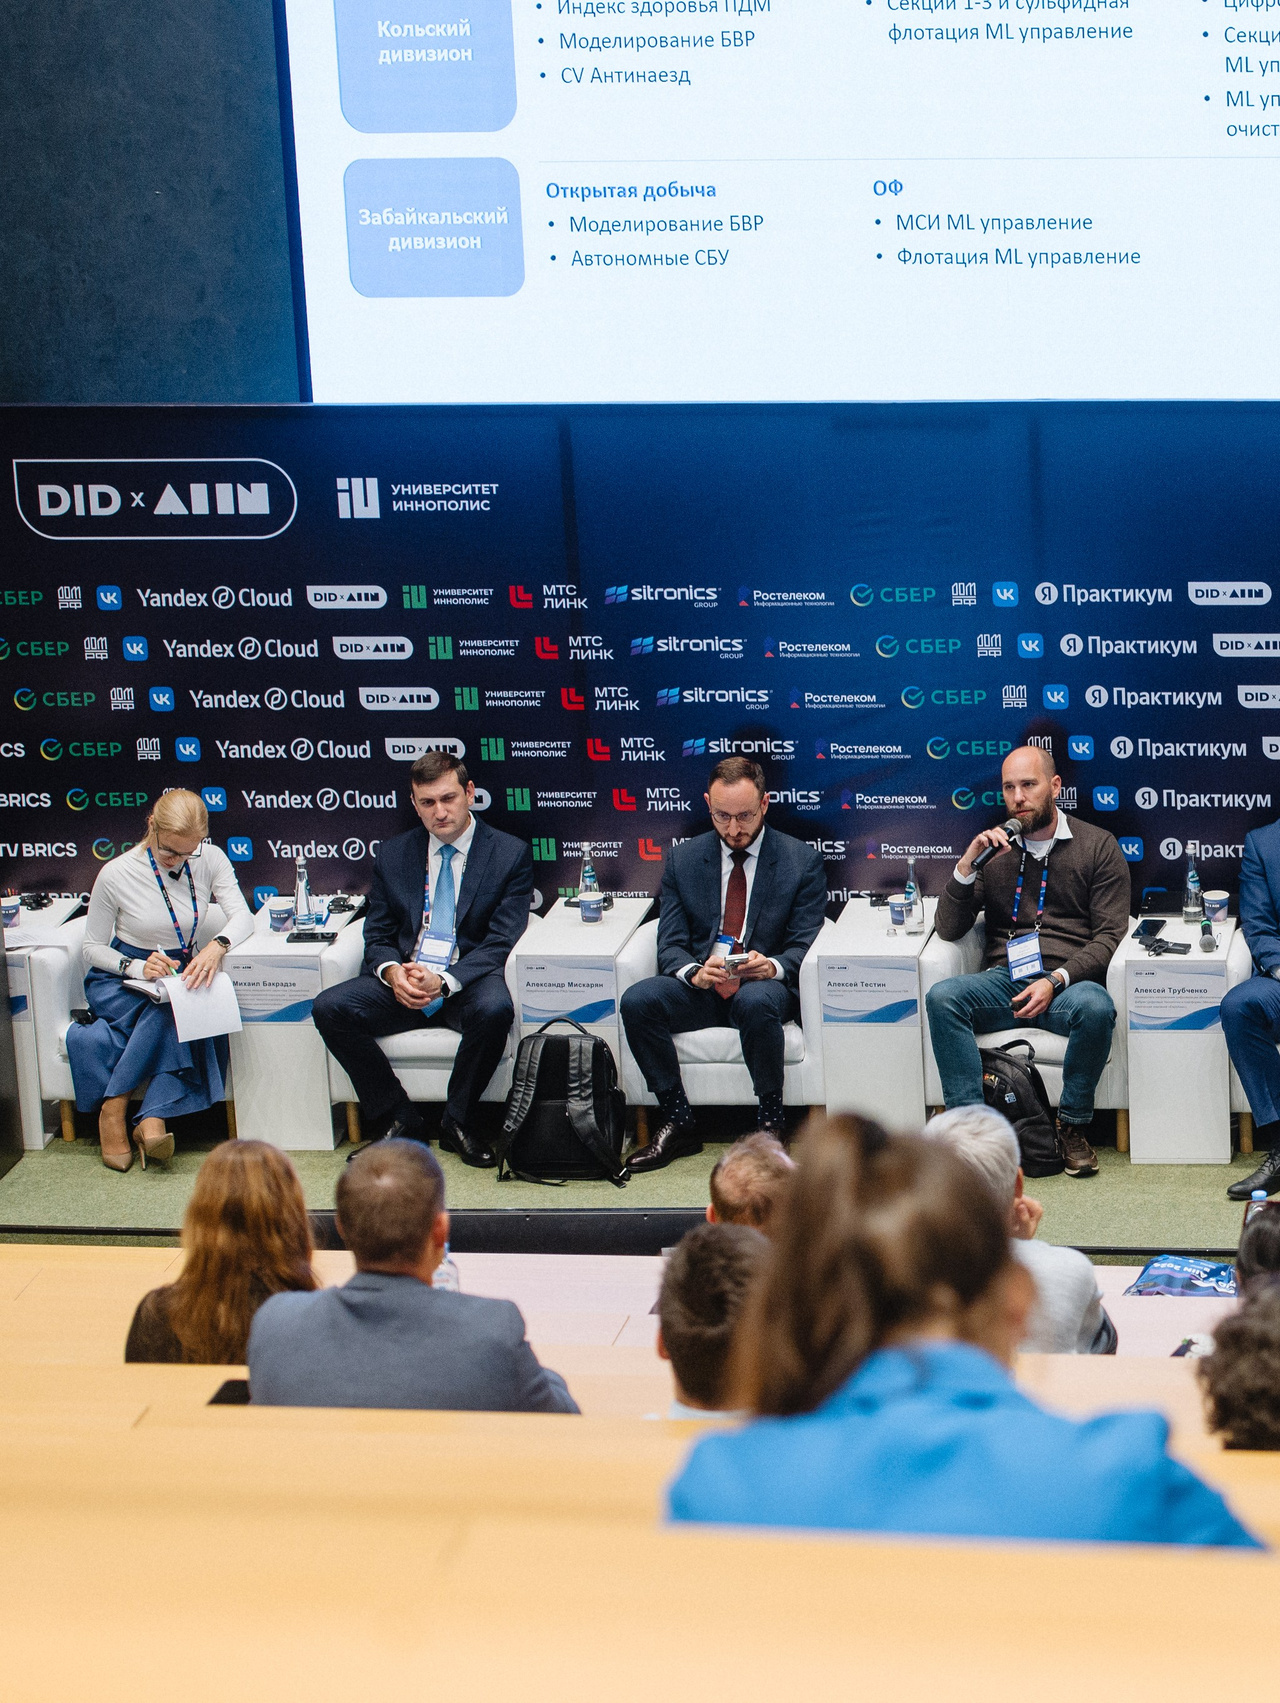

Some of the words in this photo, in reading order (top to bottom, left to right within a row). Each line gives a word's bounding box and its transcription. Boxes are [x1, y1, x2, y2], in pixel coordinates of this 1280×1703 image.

[558, 0, 625, 17] Индекс
[631, 0, 717, 17] здоровья
[725, 0, 770, 16] ПДМ
[378, 19, 470, 37] Кольский
[889, 23, 978, 44] флотация
[986, 23, 1014, 39] ML
[1019, 27, 1132, 43] управление
[560, 33, 714, 52] Моделирование
[721, 31, 755, 47] БВР
[379, 49, 472, 64] дивизион
[1226, 57, 1253, 72] ML
[561, 68, 584, 83] CV
[591, 67, 691, 85] Антинаезд
[1227, 91, 1254, 106] ML
[546, 183, 637, 202] Открытая
[643, 181, 716, 201] добыча
[873, 179, 903, 196] ОФ
[359, 207, 507, 225] Забайкальский
[570, 216, 723, 236] Моделирование
[730, 215, 763, 231] БВР
[897, 214, 940, 230] МСИ
[948, 214, 975, 230] ML
[980, 218, 1092, 234] управление
[389, 237, 481, 252] дивизион
[572, 250, 689, 266] Автономные
[695, 250, 729, 265] СБУ
[898, 248, 988, 267] Флотация
[996, 248, 1022, 264] ML
[1028, 252, 1140, 268] управление
[391, 484, 499, 495] УНИВЕРСИТЕТ
[38, 485, 121, 516] DID
[393, 500, 490, 511] ИННОПОЛИС
[137, 589, 208, 607] Yandex
[239, 588, 292, 606] Cloud
[543, 585, 576, 595] МТС
[631, 585, 717, 600] sitronics
[754, 590, 825, 600] Ростелеком
[880, 588, 936, 602] СБЕР
[1063, 585, 1172, 605] Практикум
[544, 598, 588, 608] ЛИНК
[163, 640, 234, 657] Yandex
[265, 639, 318, 657] Cloud
[569, 636, 602, 646] МТС
[779, 642, 850, 651] Ростелеком
[1022, 640, 1039, 651] VK
[16, 642, 69, 656] СБЕР
[570, 649, 614, 659] ЛИНК
[189, 690, 261, 708] Yandex
[291, 690, 344, 708] Cloud
[683, 687, 769, 702] sitronics
[931, 690, 986, 704] СБЕР
[1113, 687, 1222, 708] Практикум
[831, 743, 901, 753] Ростелеком
[242, 791, 313, 808] Yandex
[343, 790, 396, 808] Cloud
[647, 788, 680, 798] МТС
[1163, 790, 1271, 810] Практикум
[647, 801, 691, 811] ЛИНК
[22, 843, 77, 857] BRICS
